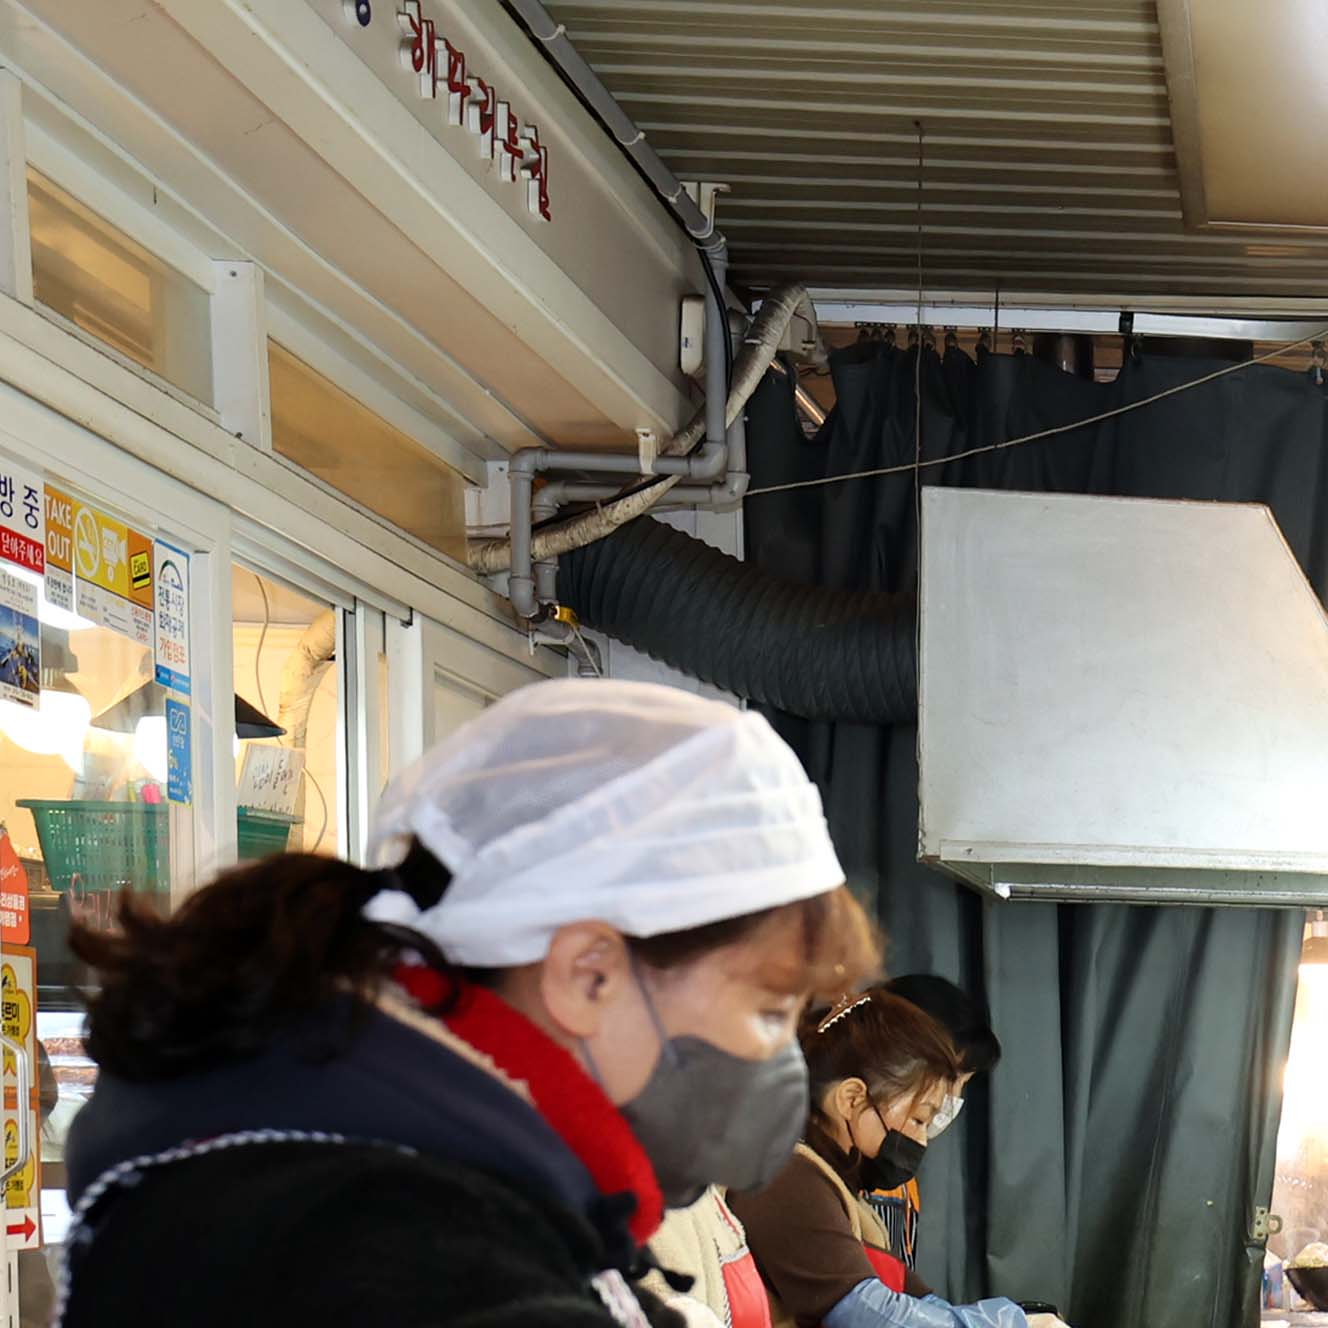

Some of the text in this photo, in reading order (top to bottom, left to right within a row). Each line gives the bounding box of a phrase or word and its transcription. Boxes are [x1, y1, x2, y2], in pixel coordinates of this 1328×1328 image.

[22, 485, 40, 529] 중
[44, 494, 72, 529] TAKE
[47, 530, 71, 563] OUT
